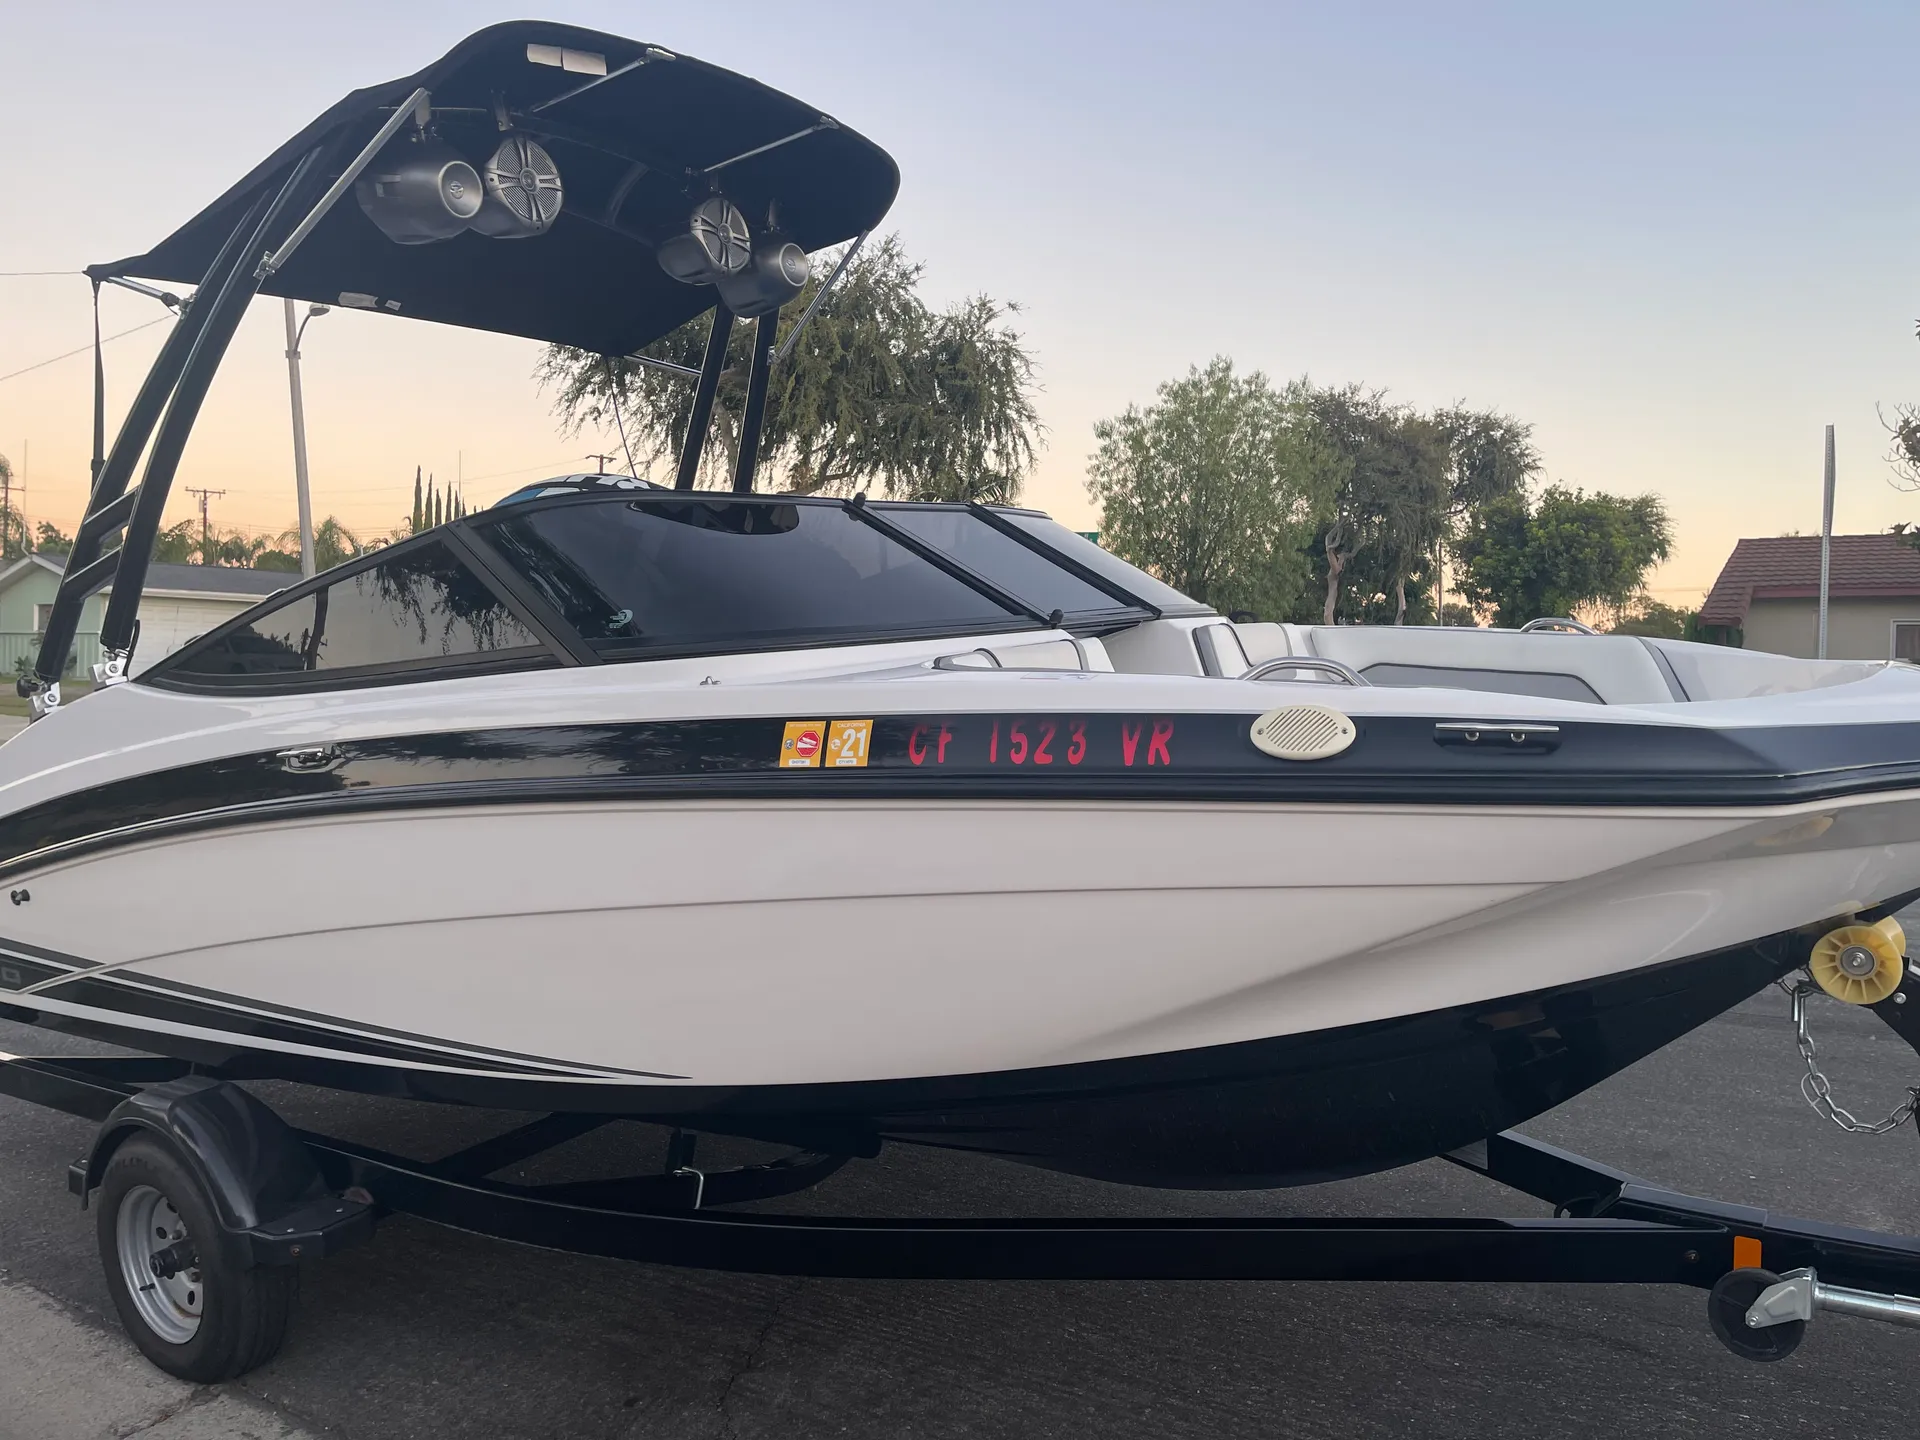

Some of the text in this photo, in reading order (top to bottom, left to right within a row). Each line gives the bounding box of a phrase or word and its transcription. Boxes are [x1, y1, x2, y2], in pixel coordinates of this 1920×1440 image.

[840, 728, 867, 757] 21
[908, 718, 1175, 766] CF 1523 VR
